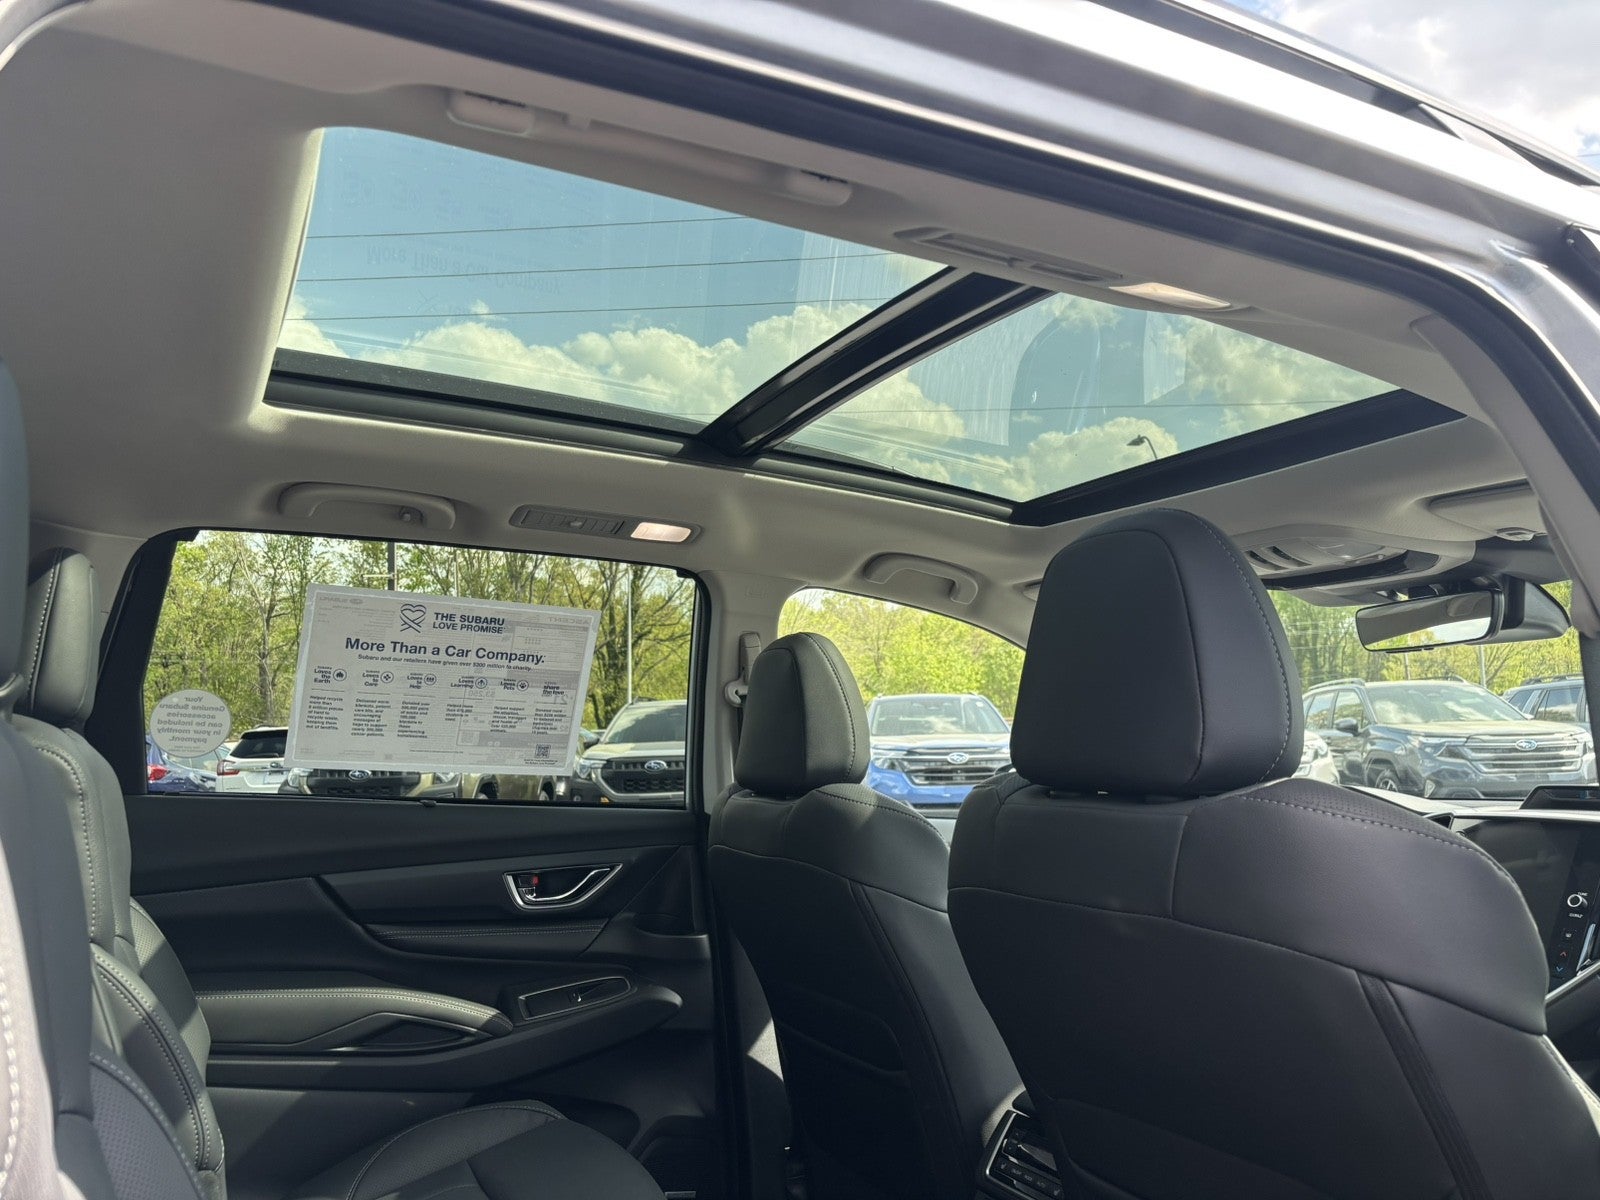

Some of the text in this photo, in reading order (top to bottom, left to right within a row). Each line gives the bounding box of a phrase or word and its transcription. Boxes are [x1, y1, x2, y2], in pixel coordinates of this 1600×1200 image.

[434, 612, 505, 626] THE SUBARU
[432, 622, 504, 634] LOVE PROMISE
[345, 637, 545, 665] More Than a Car Company.
